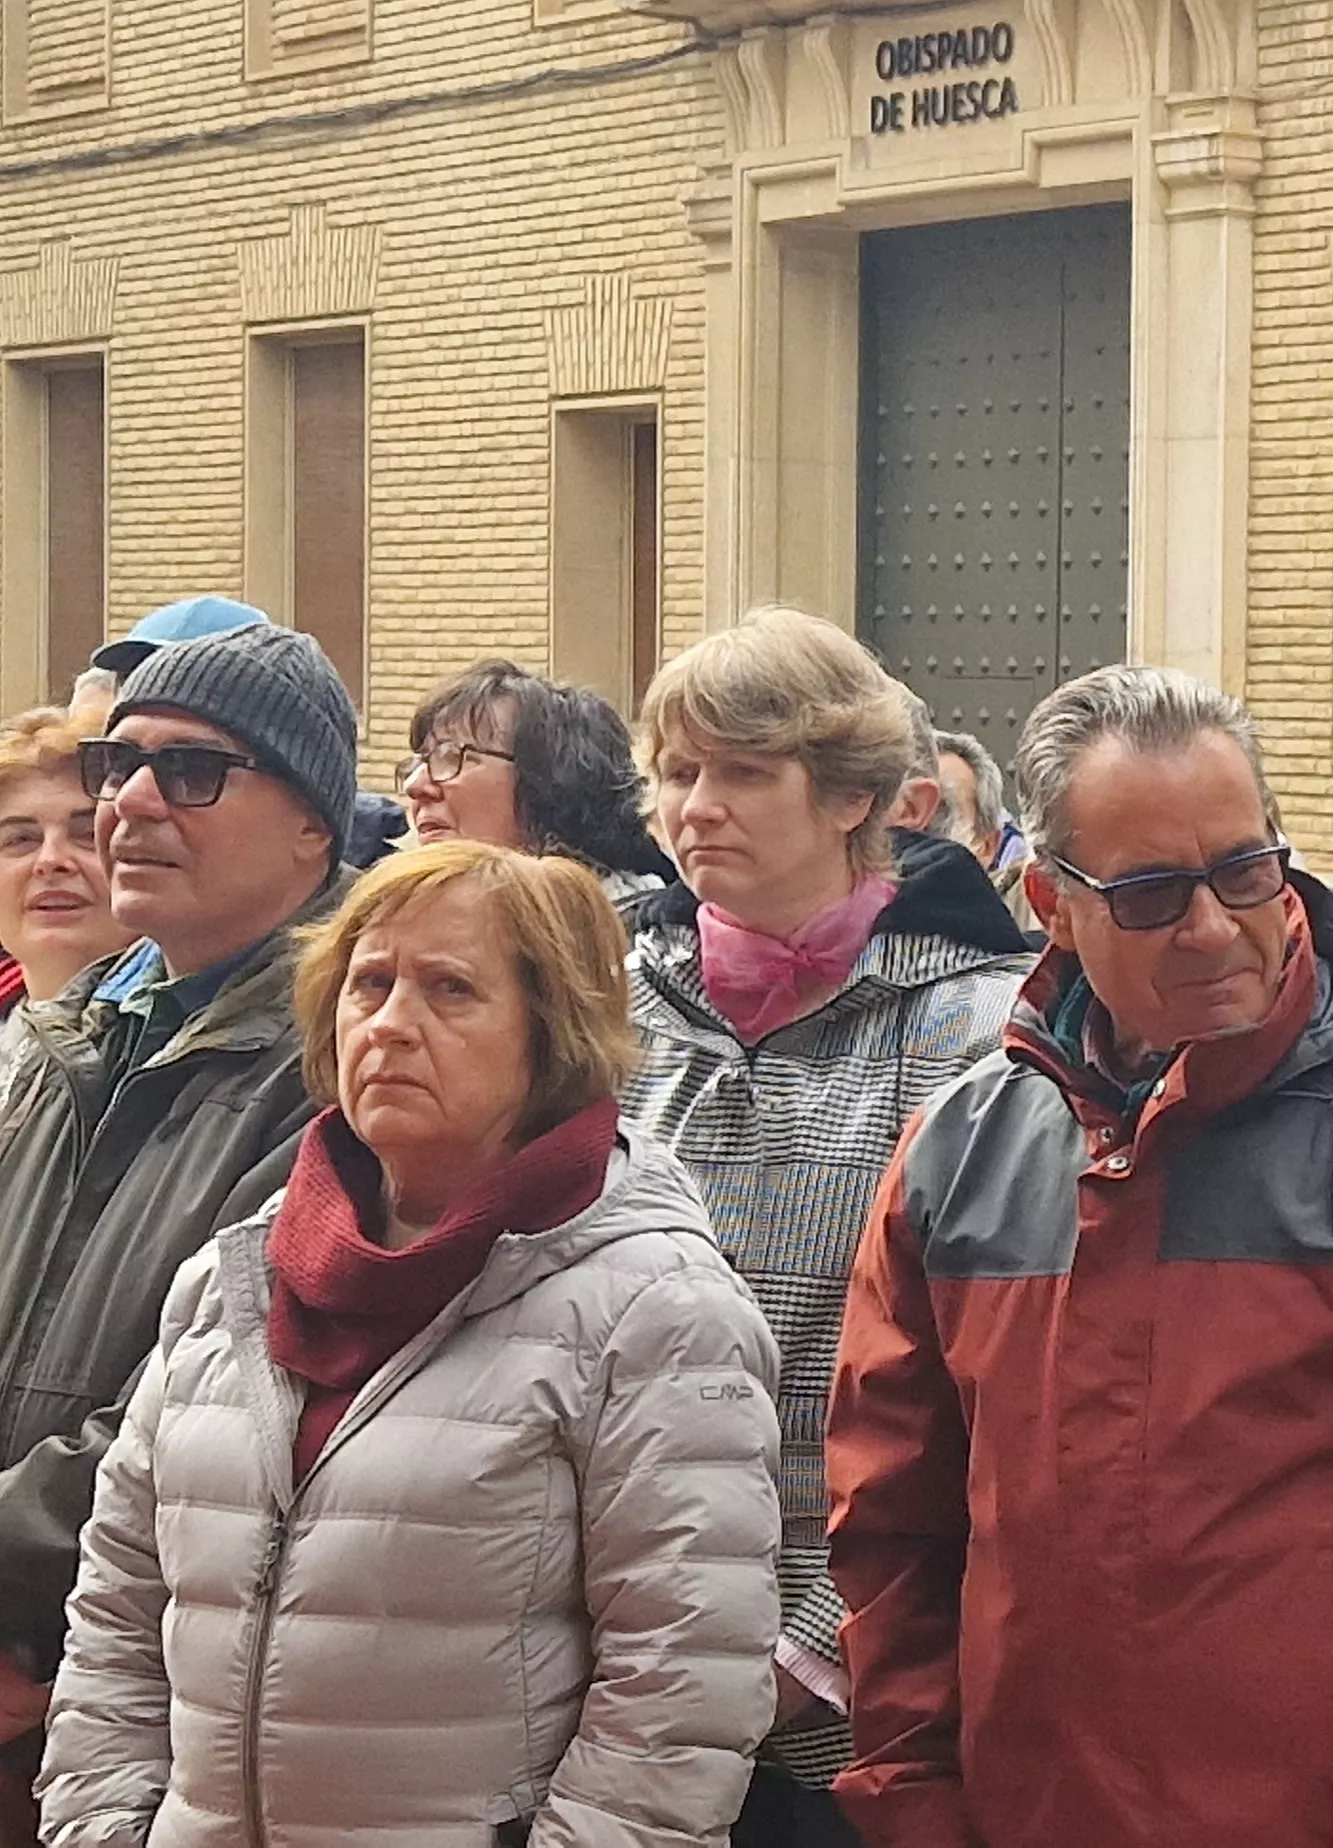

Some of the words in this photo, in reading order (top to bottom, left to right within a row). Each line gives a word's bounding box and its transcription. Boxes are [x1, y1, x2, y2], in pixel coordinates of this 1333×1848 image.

[875, 22, 1013, 80] OBISPADO
[870, 92, 906, 134] DE
[911, 76, 1018, 129] HUESCA
